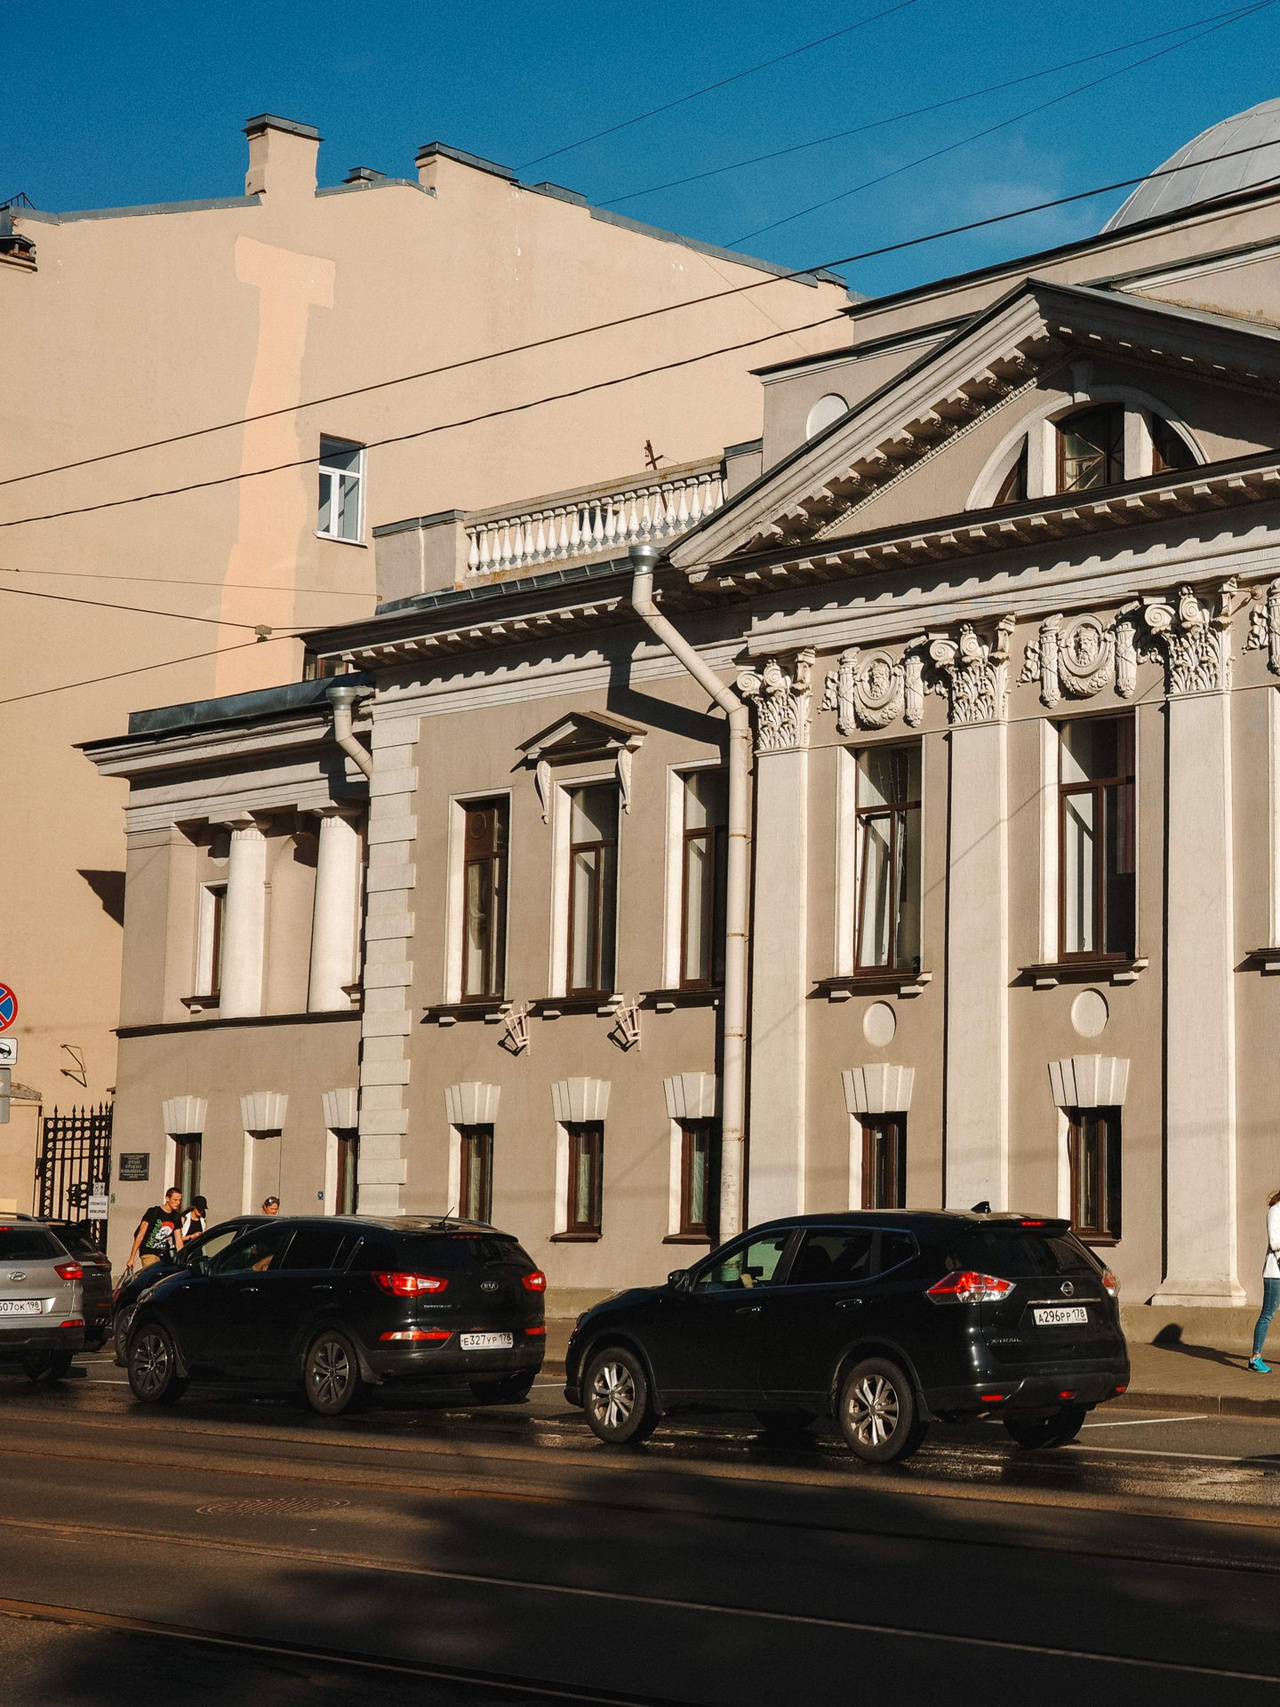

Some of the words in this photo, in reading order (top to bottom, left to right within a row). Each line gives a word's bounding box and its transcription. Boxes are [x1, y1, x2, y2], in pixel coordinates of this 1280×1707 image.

[27, 1301, 40, 1310] 198
[1072, 1308, 1085, 1319] 178
[499, 1333, 512, 1342] 178
